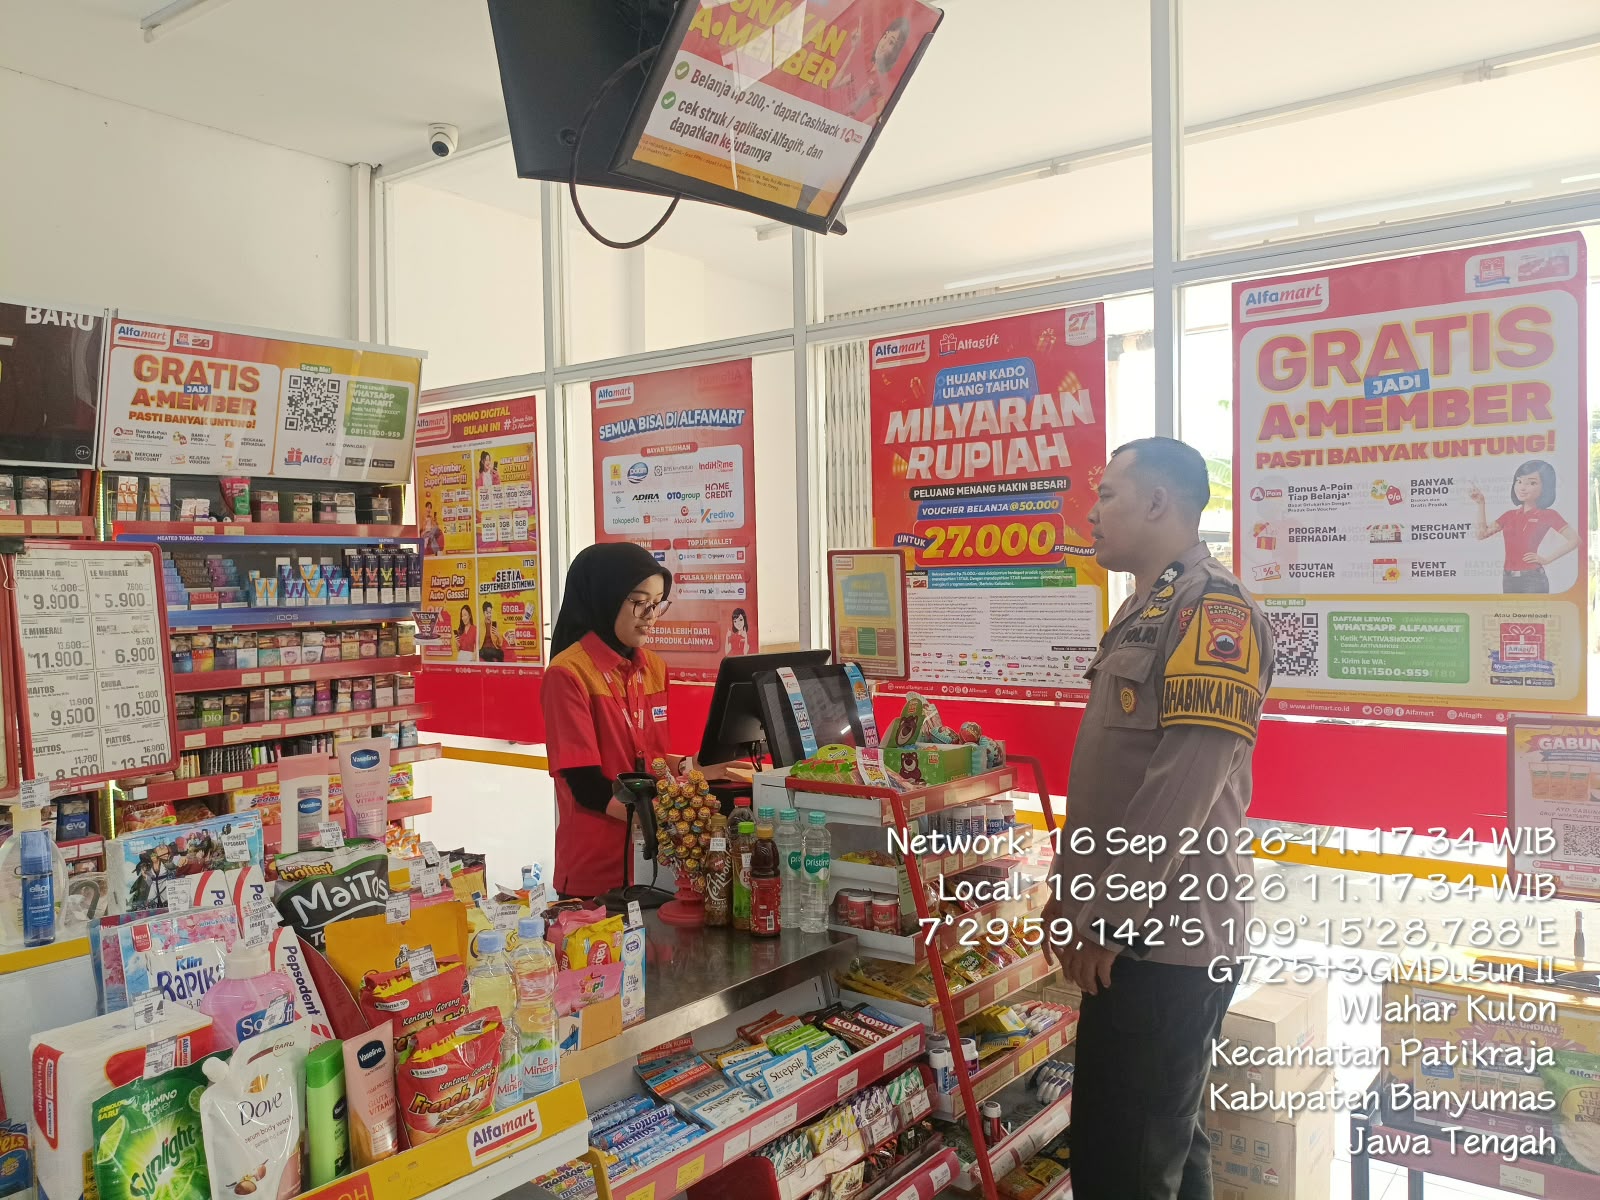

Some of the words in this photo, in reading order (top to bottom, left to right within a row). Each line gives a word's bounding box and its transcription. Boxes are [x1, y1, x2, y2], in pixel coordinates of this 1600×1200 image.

[690, 69, 731, 99] Belanja
[774, 102, 800, 126] dapat
[800, 111, 840, 138] Cashback
[670, 117, 719, 148] dapatkan
[678, 99, 700, 117] cek
[699, 105, 727, 128] struk
[734, 117, 771, 145] aplikasi
[806, 144, 824, 160] dan
[1246, 283, 1322, 307] Alfamart
[25, 305, 95, 332] BARU
[117, 324, 167, 342] Alfamart
[875, 339, 926, 357] Alfamart
[957, 333, 999, 351] Alfagift
[1257, 306, 1555, 392] GRATIS
[133, 353, 261, 395] GRATIS
[946, 370, 986, 385] HUJAN
[990, 366, 1026, 381] KADO
[598, 386, 631, 399] Alfamart
[943, 384, 984, 399] ULANG
[986, 378, 1029, 394] TAHUN
[1372, 375, 1422, 396] JADI
[129, 410, 162, 424] PASTI
[164, 412, 207, 426] BANYAK
[453, 412, 480, 424] PROMO
[480, 406, 510, 420] DIGITAL
[884, 389, 1096, 445] MILYARAN
[464, 423, 489, 435] BULAN
[490, 422, 501, 432] INI
[600, 420, 637, 440] SEMUA
[638, 413, 664, 432] BISA
[666, 411, 679, 428] DI
[680, 408, 746, 427] ALFAMART
[906, 432, 1072, 480] RUPIAH
[1256, 448, 1323, 470] PASTI
[1327, 442, 1429, 466] BANYAK
[1431, 429, 1556, 460] UNTUNG!
[430, 463, 463, 476] September
[699, 460, 733, 470] IndiHome
[705, 482, 730, 491] HOME
[914, 486, 955, 499] PELUANG
[956, 483, 997, 496] MENANG
[998, 481, 1028, 493] MAKIN
[1030, 479, 1067, 490] BESAR!
[1288, 485, 1318, 493] Bonus
[1320, 483, 1353, 492] A-Poin
[1410, 477, 1454, 487] BANYAK
[667, 491, 700, 501] OTOgroup
[705, 490, 733, 500] CREDIT
[1288, 493, 1308, 501] Tiap
[1410, 487, 1449, 496] PROMO
[701, 508, 735, 523] Kredivo
[922, 505, 965, 516] VOUCHER
[967, 503, 1009, 513] BELANJA
[1010, 500, 1059, 512] @50.000
[612, 517, 640, 525] tokopedia
[1411, 523, 1471, 532] MERCHANT
[1288, 526, 1337, 535] PROGRAM
[1288, 534, 1347, 543] BERHADIAH
[1411, 531, 1467, 541] DISCOUNT
[897, 534, 927, 547] UNTUK
[922, 521, 1057, 559] 27.000
[1054, 545, 1096, 555] PEMENANG
[1288, 562, 1334, 571] KEJUTAN
[1411, 561, 1447, 569] EVENT
[431, 575, 451, 588] Harga
[452, 574, 465, 586] Pas
[496, 570, 521, 583] SETIA
[1288, 570, 1336, 579] VOUCHER
[1411, 569, 1457, 578] MEMBER
[480, 580, 510, 592] SEPTEMBER
[511, 579, 535, 590] ISTIMEWA
[33, 593, 80, 610] 9.900
[104, 592, 145, 608] 5.900
[430, 590, 445, 601] Auto
[1266, 598, 1285, 607] Scan
[1287, 598, 1304, 607] Me!
[1208, 604, 1246, 618] POLRESTA
[673, 627, 693, 635] LEBIH
[694, 627, 710, 635] DARI
[1333, 623, 1397, 632] WHATSAPP
[1398, 624, 1462, 633] ALFAMART
[33, 651, 83, 669] 11.900
[115, 647, 156, 664] 6.900
[1341, 657, 1360, 665] Kirim
[1371, 658, 1386, 666] WA:
[1341, 666, 1430, 677] 0811-1500-959
[114, 700, 161, 719] 10.500
[1163, 678, 1260, 729] BHABINKAMTIBM
[1289, 702, 1351, 712] www.alfamart.co.id
[1405, 708, 1435, 717] Alfamart
[1457, 711, 1483, 720] Alfagift
[51, 707, 95, 726] 9.500
[106, 735, 131, 745] PIATTOS
[351, 755, 378, 764] Vaseline
[300, 802, 321, 811] Vaseline
[66, 822, 86, 831] evo
[805, 857, 830, 867] pristine
[176, 956, 203, 972] Klin
[283, 945, 323, 1019] Pepsodent
[402, 1007, 434, 1027] Kentang
[435, 996, 461, 1014] Goreng
[833, 1016, 883, 1043] KOPIKO
[1521, 1021, 1559, 1034] UNDIAN
[274, 1040, 296, 1052] BARU
[358, 1046, 385, 1064] Vaseline
[537, 1055, 549, 1066] Le
[438, 1072, 469, 1093] Kentang
[470, 1059, 494, 1077] Goreng
[408, 1081, 472, 1115] French
[238, 1092, 283, 1127] Dove
[472, 1106, 538, 1148] Alfamart
[130, 1124, 196, 1200] Sunlight
